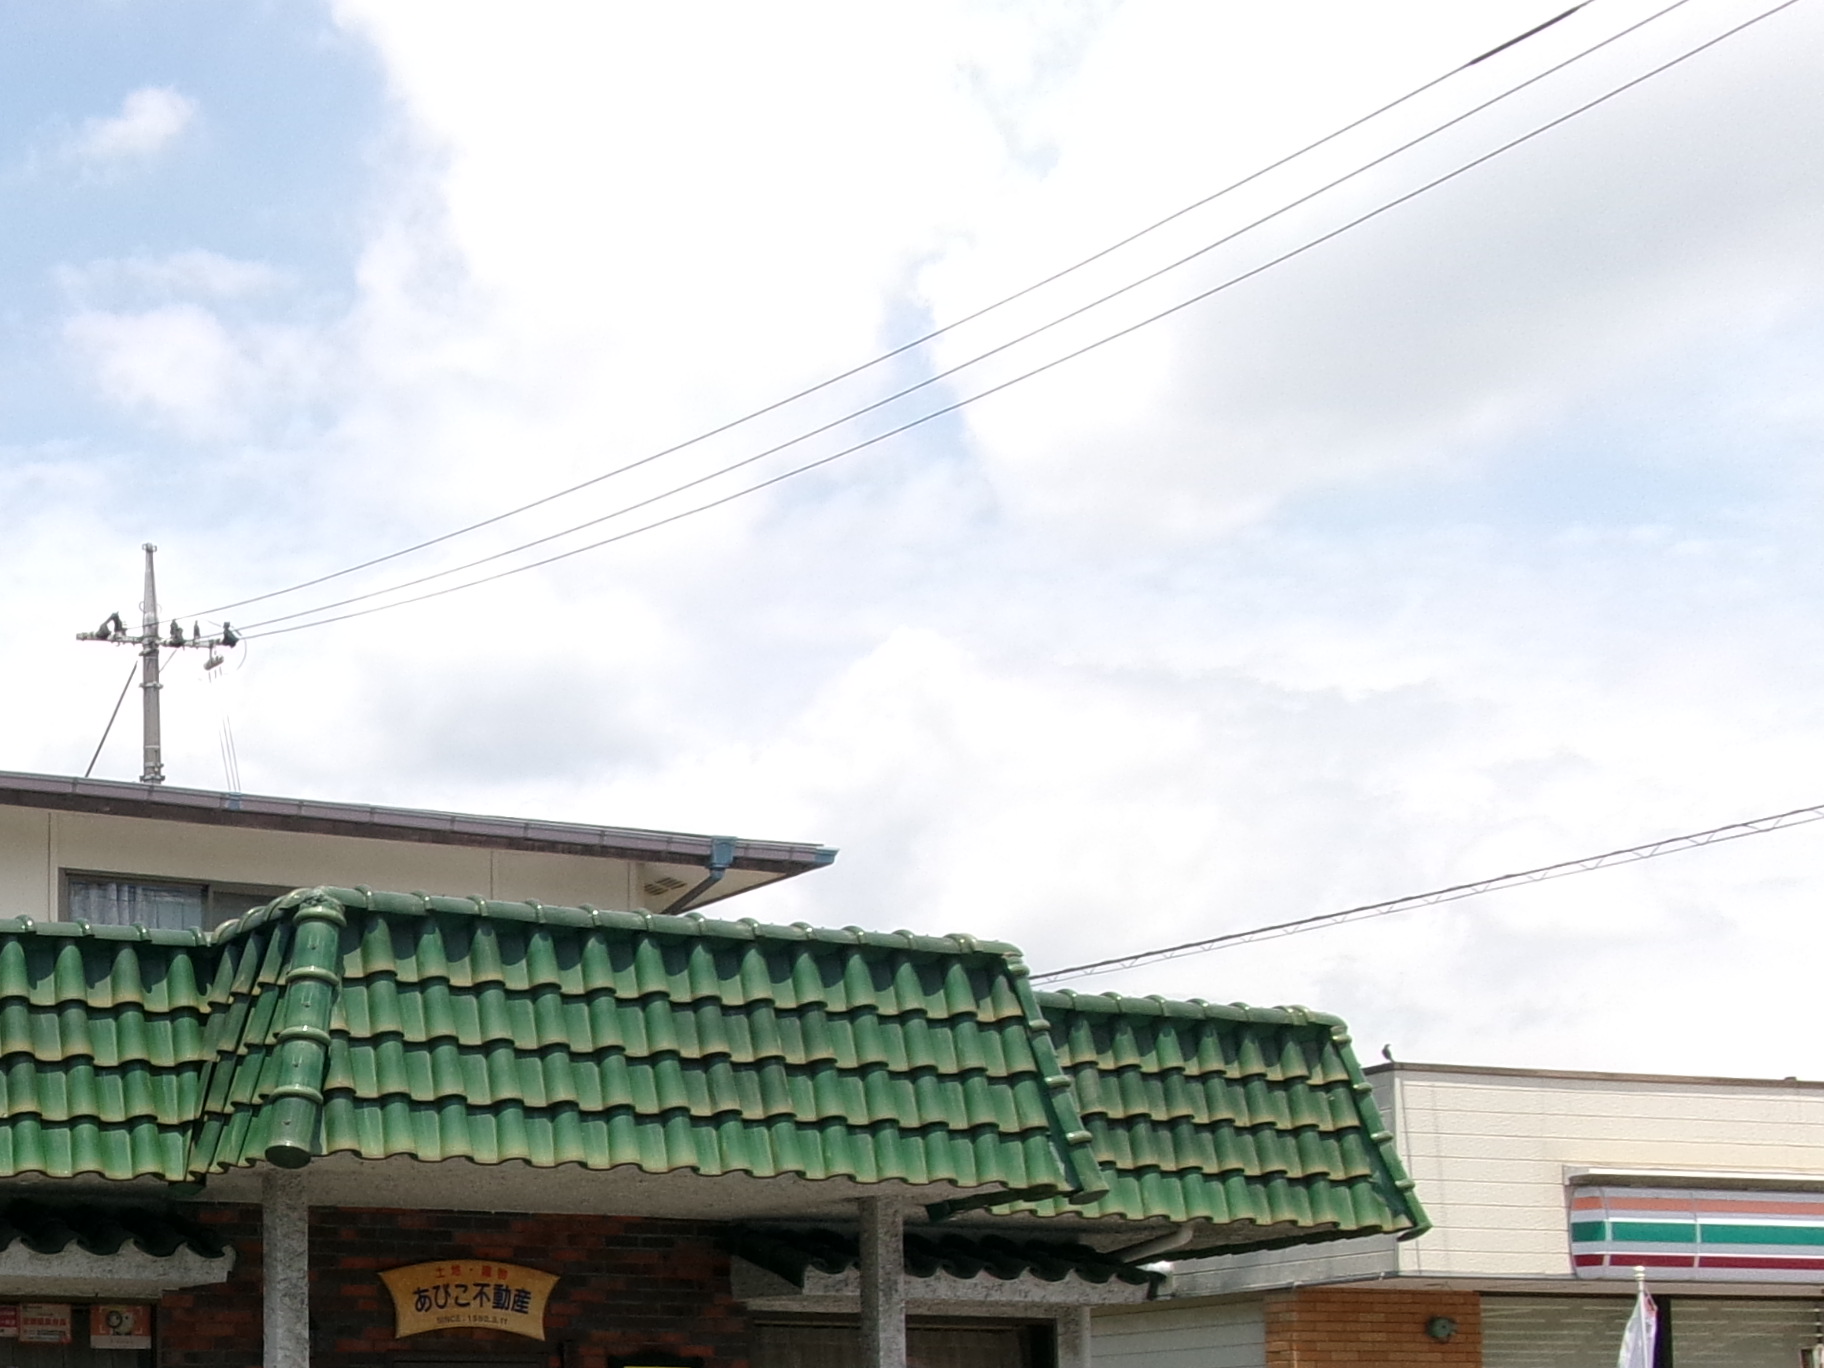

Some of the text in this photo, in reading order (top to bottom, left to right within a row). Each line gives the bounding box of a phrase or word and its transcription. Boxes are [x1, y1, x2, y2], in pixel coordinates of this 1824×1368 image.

[412, 1283, 532, 1315] あびこ不動産
